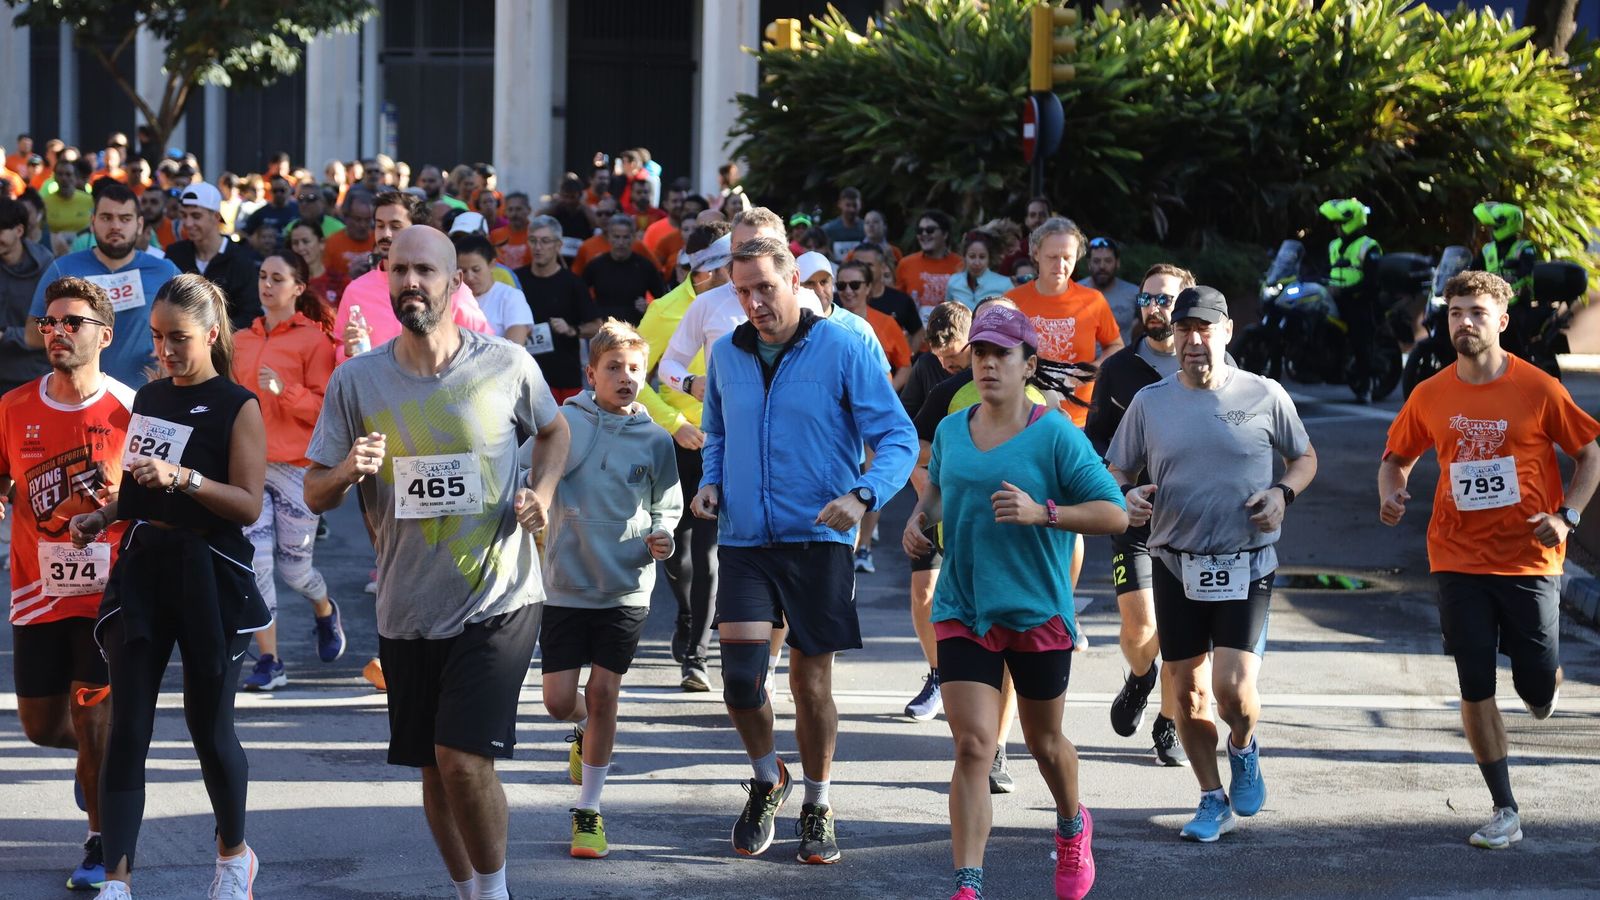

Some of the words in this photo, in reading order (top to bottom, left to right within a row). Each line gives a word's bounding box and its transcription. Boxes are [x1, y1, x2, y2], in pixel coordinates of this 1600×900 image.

[108, 285, 133, 300] 32
[128, 434, 172, 461] 624
[28, 466, 61, 498] FLYING
[408, 476, 466, 499] 465
[1459, 476, 1505, 496] 793
[31, 483, 62, 517] FEET
[50, 562, 97, 581] 374
[1199, 570, 1230, 587] 29
